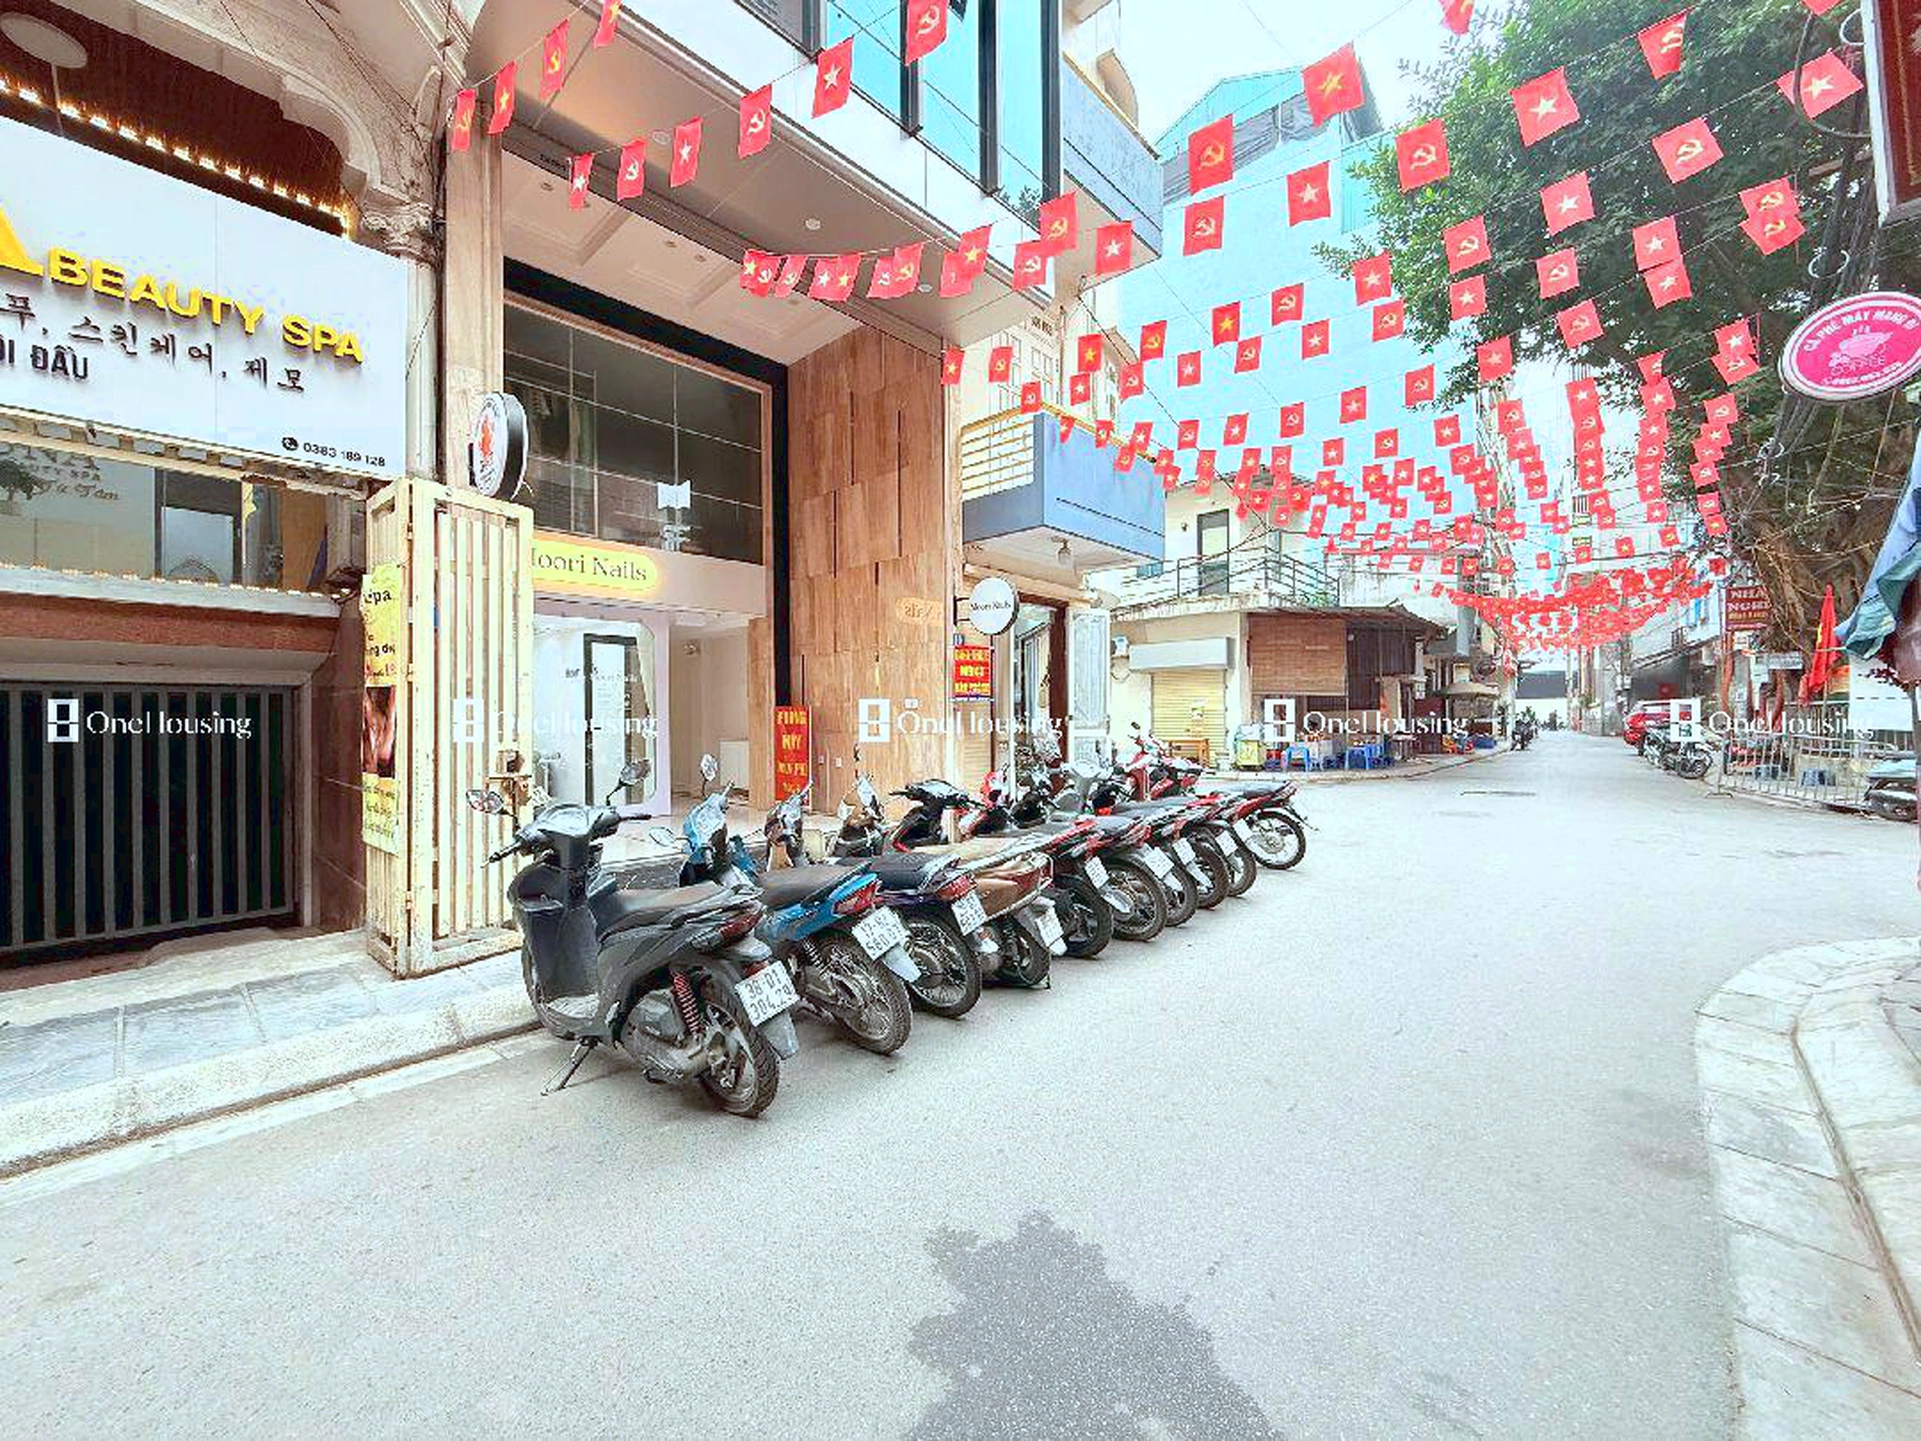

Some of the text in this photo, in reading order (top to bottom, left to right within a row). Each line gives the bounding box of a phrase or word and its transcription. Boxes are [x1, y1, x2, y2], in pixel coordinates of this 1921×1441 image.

[49, 247, 363, 363] BEAUTY SPA
[303, 442, 337, 458] 0383
[365, 455, 385, 467] 128
[531, 547, 646, 581] oori Nails
